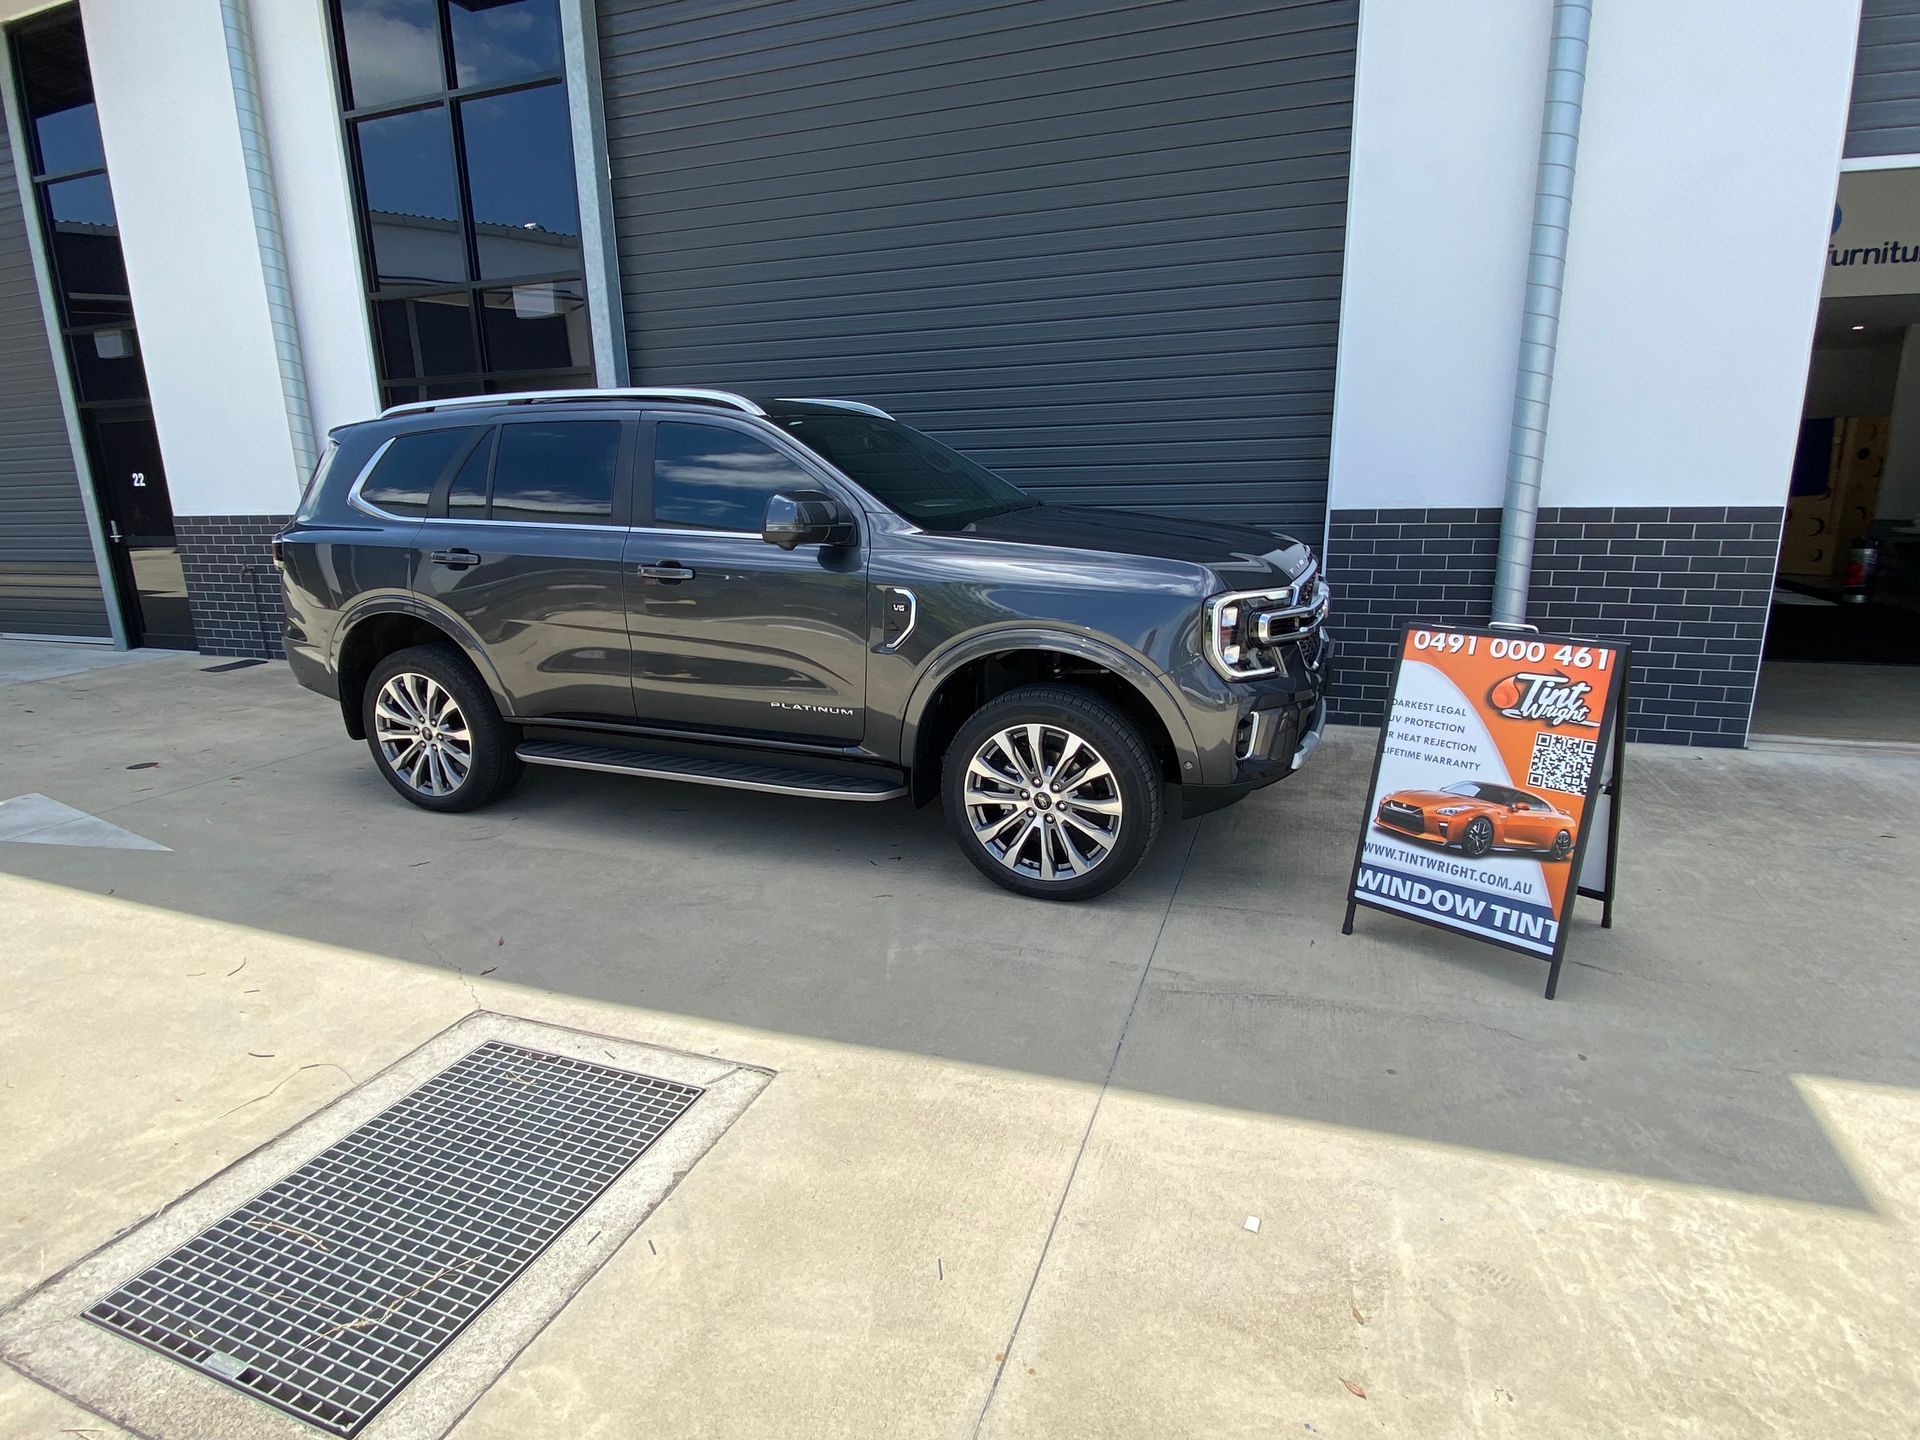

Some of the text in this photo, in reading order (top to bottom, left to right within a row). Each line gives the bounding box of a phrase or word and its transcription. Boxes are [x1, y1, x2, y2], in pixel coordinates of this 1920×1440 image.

[132, 472, 146, 487] 22
[1413, 630, 1610, 670] 0491 000 461
[1516, 672, 1592, 712] Tint
[770, 701, 854, 716] PLATINUM
[1436, 704, 1467, 717] LEGAL
[1520, 703, 1590, 726] Wright
[1404, 716, 1465, 734] PROTECTION
[1397, 731, 1422, 744] HEAT
[1423, 736, 1478, 753] REJECTION
[1424, 753, 1481, 771] WARRANTY
[1364, 841, 1533, 895] WWW.TINTWRIGHT.COM.AU
[1356, 867, 1559, 943] WINDOW TINT
